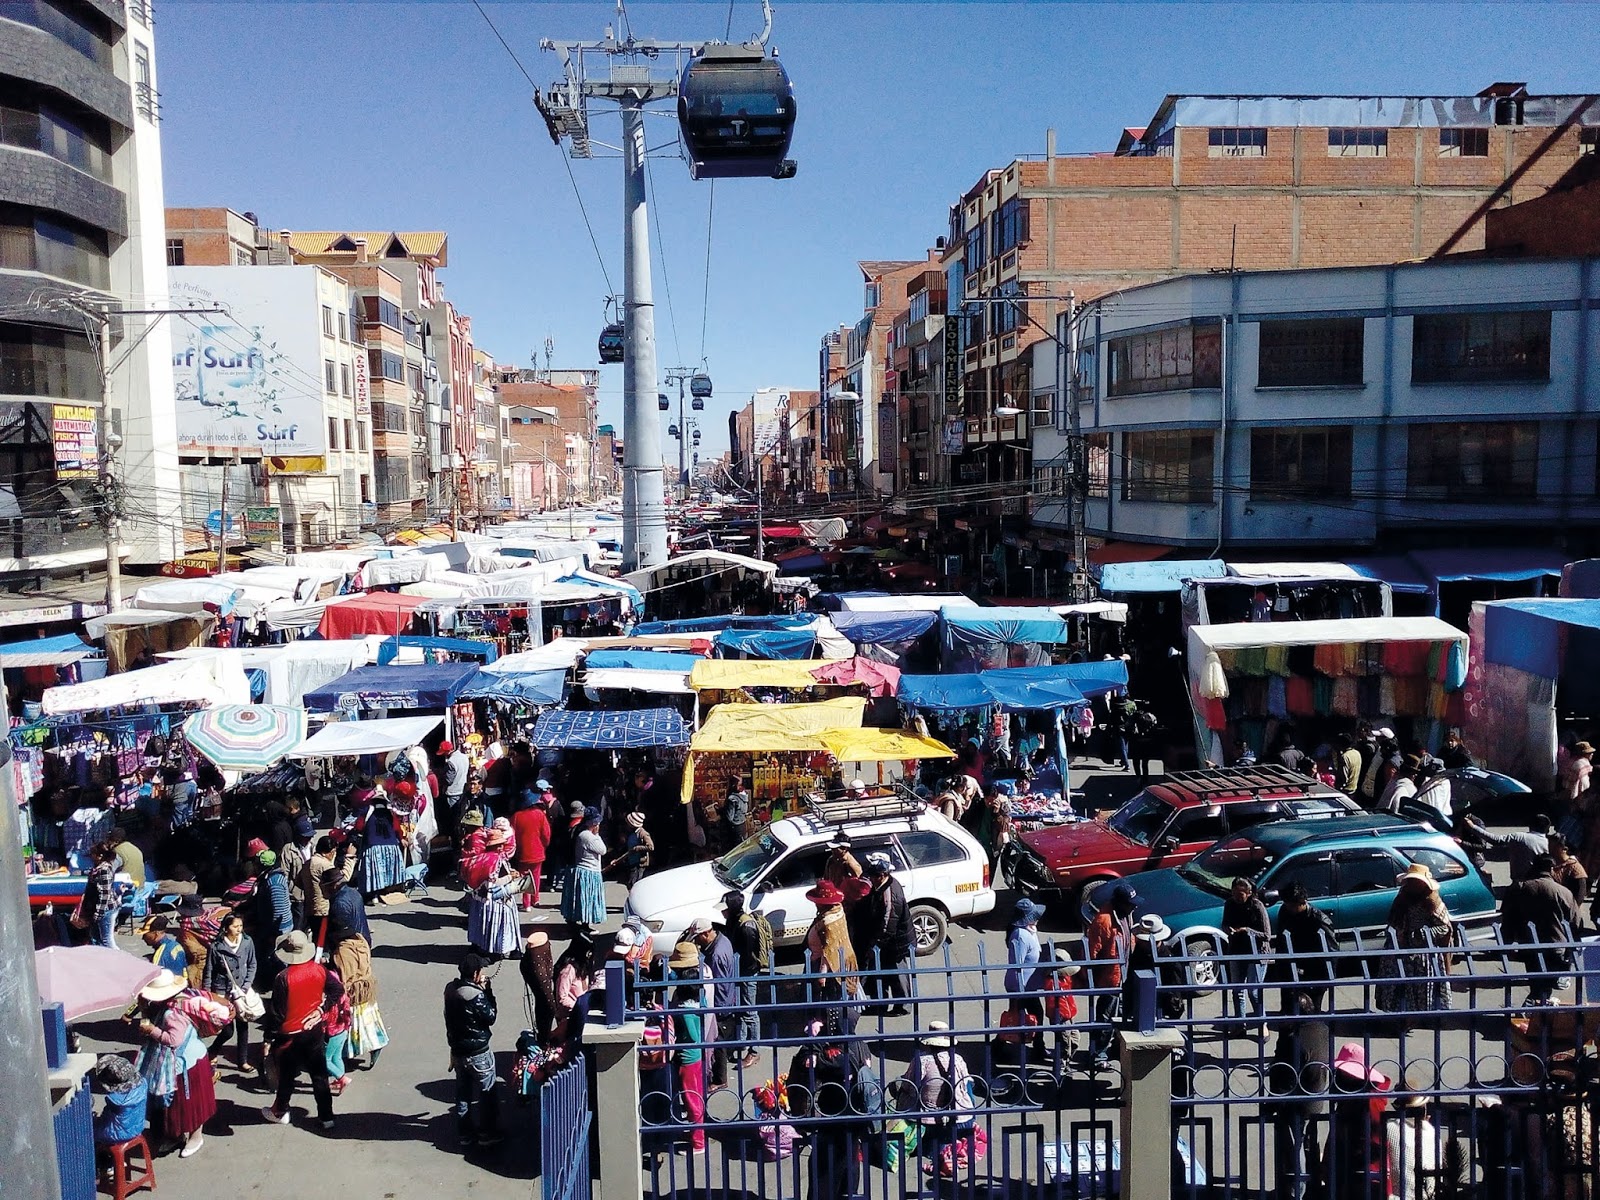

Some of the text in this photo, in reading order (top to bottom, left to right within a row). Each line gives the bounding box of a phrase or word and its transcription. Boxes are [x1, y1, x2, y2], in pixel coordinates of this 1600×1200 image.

[204, 346, 256, 368] Surf
[946, 316, 957, 401] ALOJAMIENTO
[179, 433, 196, 441] ahora
[197, 433, 214, 441] duran
[215, 433, 229, 441] todo
[257, 424, 298, 440] Surf
[43, 608, 61, 616] BELEN
